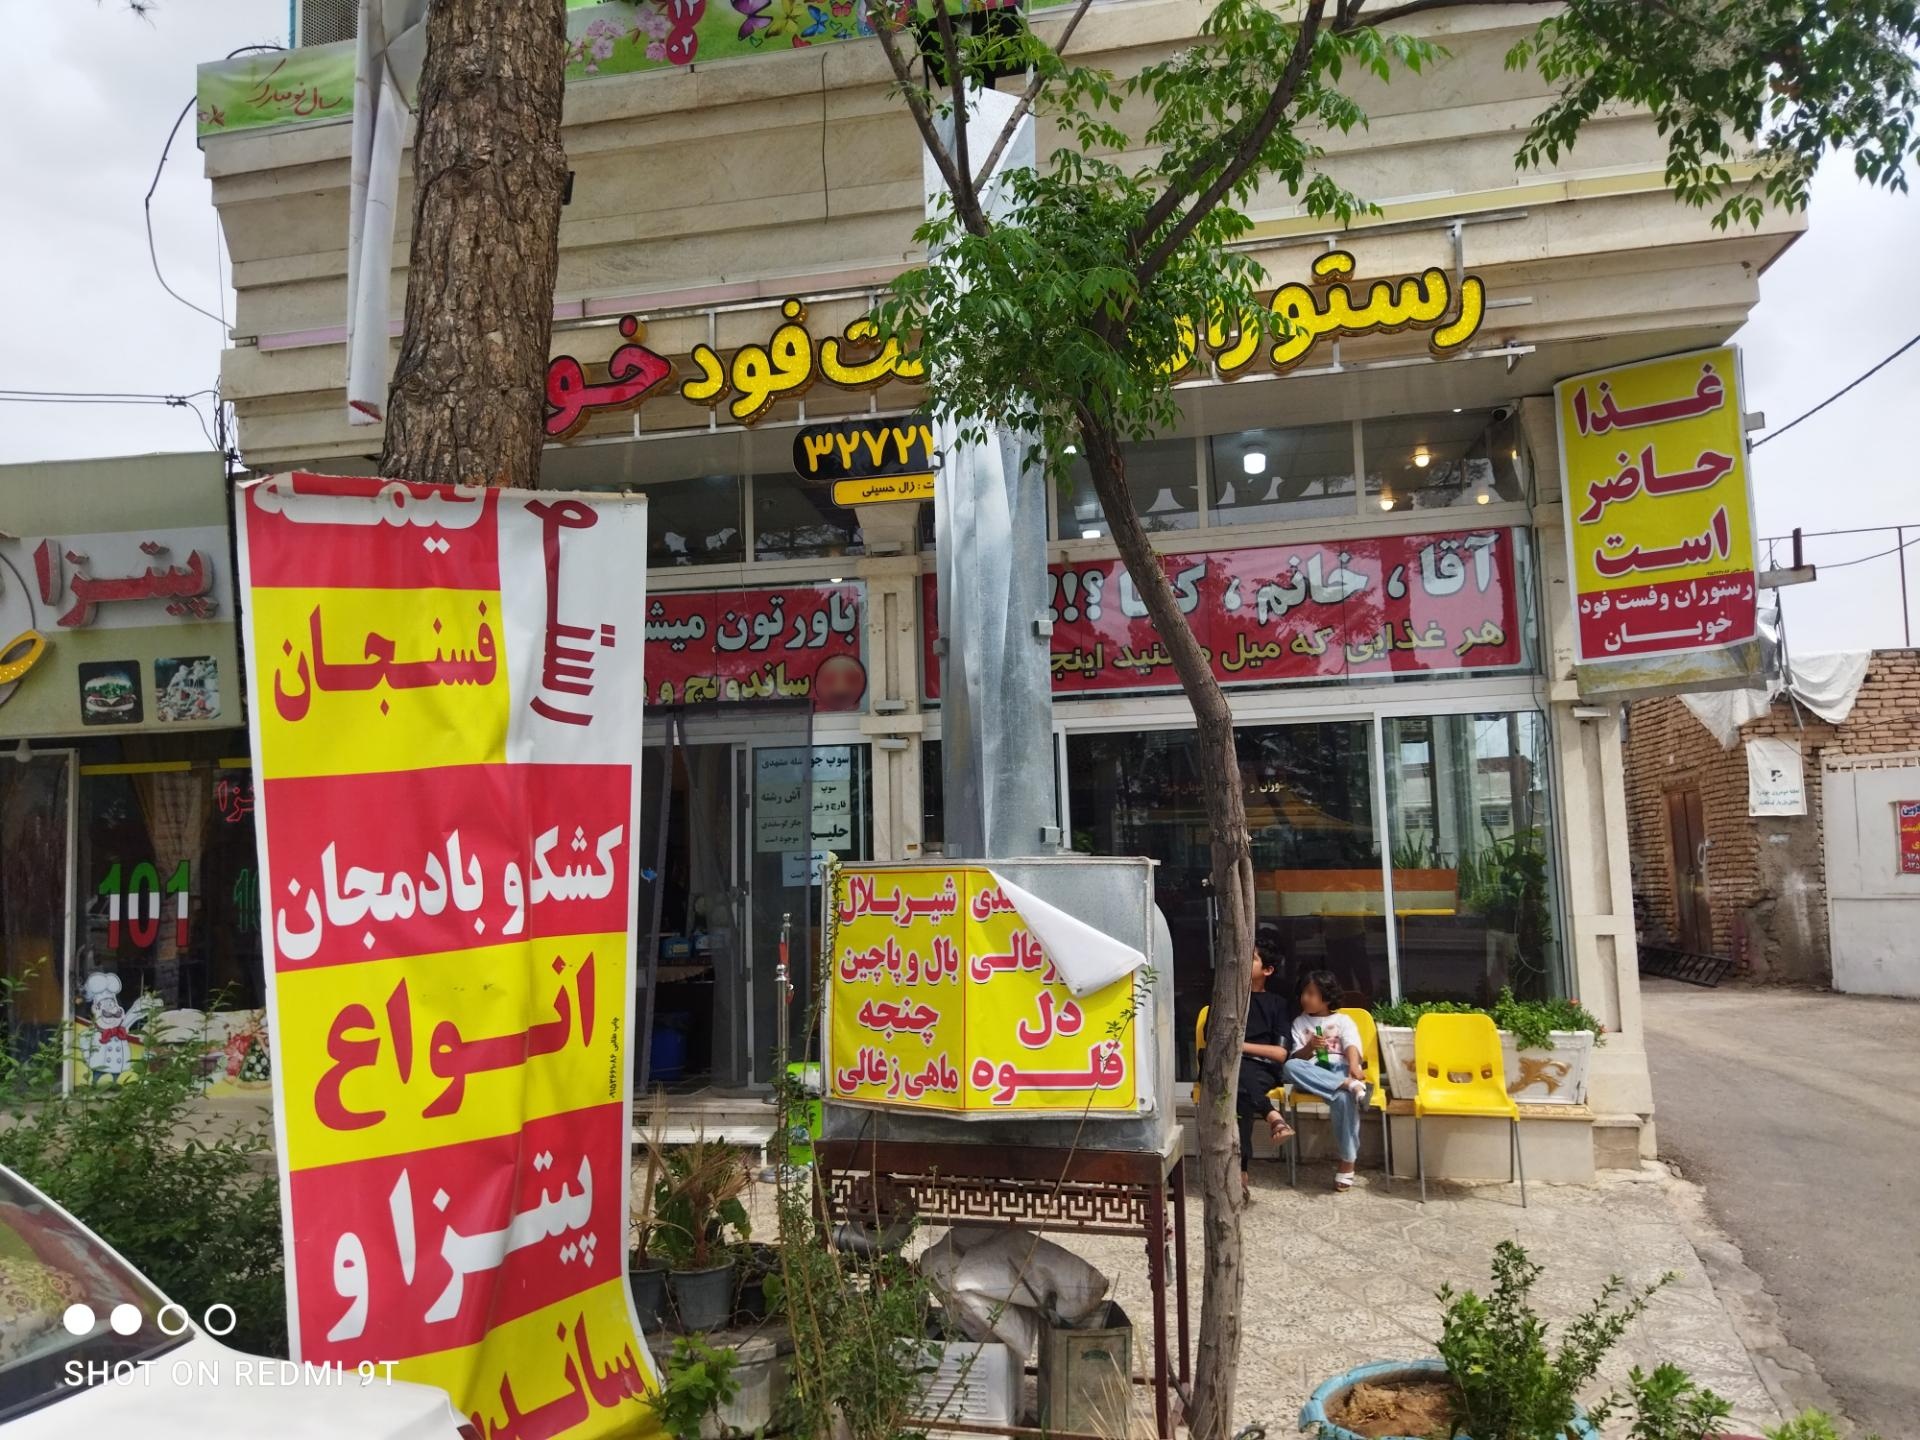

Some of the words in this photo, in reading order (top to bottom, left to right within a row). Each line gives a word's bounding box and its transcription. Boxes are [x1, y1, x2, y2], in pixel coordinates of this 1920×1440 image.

[246, 58, 292, 110] مبارک
[294, 87, 343, 116] سال
[545, 314, 672, 437] خو
[681, 298, 814, 422] فود
[1573, 362, 1725, 437] غذا
[862, 484, 896, 498] حسینی
[898, 481, 916, 494] زال
[1577, 443, 1735, 525] حاضر
[1594, 503, 1731, 579] است
[32, 537, 220, 628] پیتزا
[1580, 591, 1611, 620] فود
[1673, 579, 1754, 609] رستوران
[1219, 632, 1282, 672] میل
[1291, 627, 1334, 659] که
[1346, 620, 1447, 667] غذایی
[1457, 618, 1505, 657] هر
[1604, 610, 1733, 652] خوبان
[274, 599, 498, 723] فسنجان
[683, 660, 812, 704] ساندویچ
[1050, 642, 1104, 680] اینج
[98, 859, 191, 950] 101
[276, 828, 485, 961] بادمجان
[840, 936, 902, 984] پاچین
[906, 952, 919, 983] و
[924, 935, 958, 983] بال
[314, 951, 597, 1131] انواع
[859, 999, 940, 1045] چنجه
[1018, 991, 1083, 1049] دل
[838, 1047, 899, 1097] زغالی
[905, 1051, 959, 1099] ماهی
[971, 1041, 1124, 1104] قلوه
[389, 1149, 598, 1325] پیتزا
[326, 1231, 370, 1344] و
